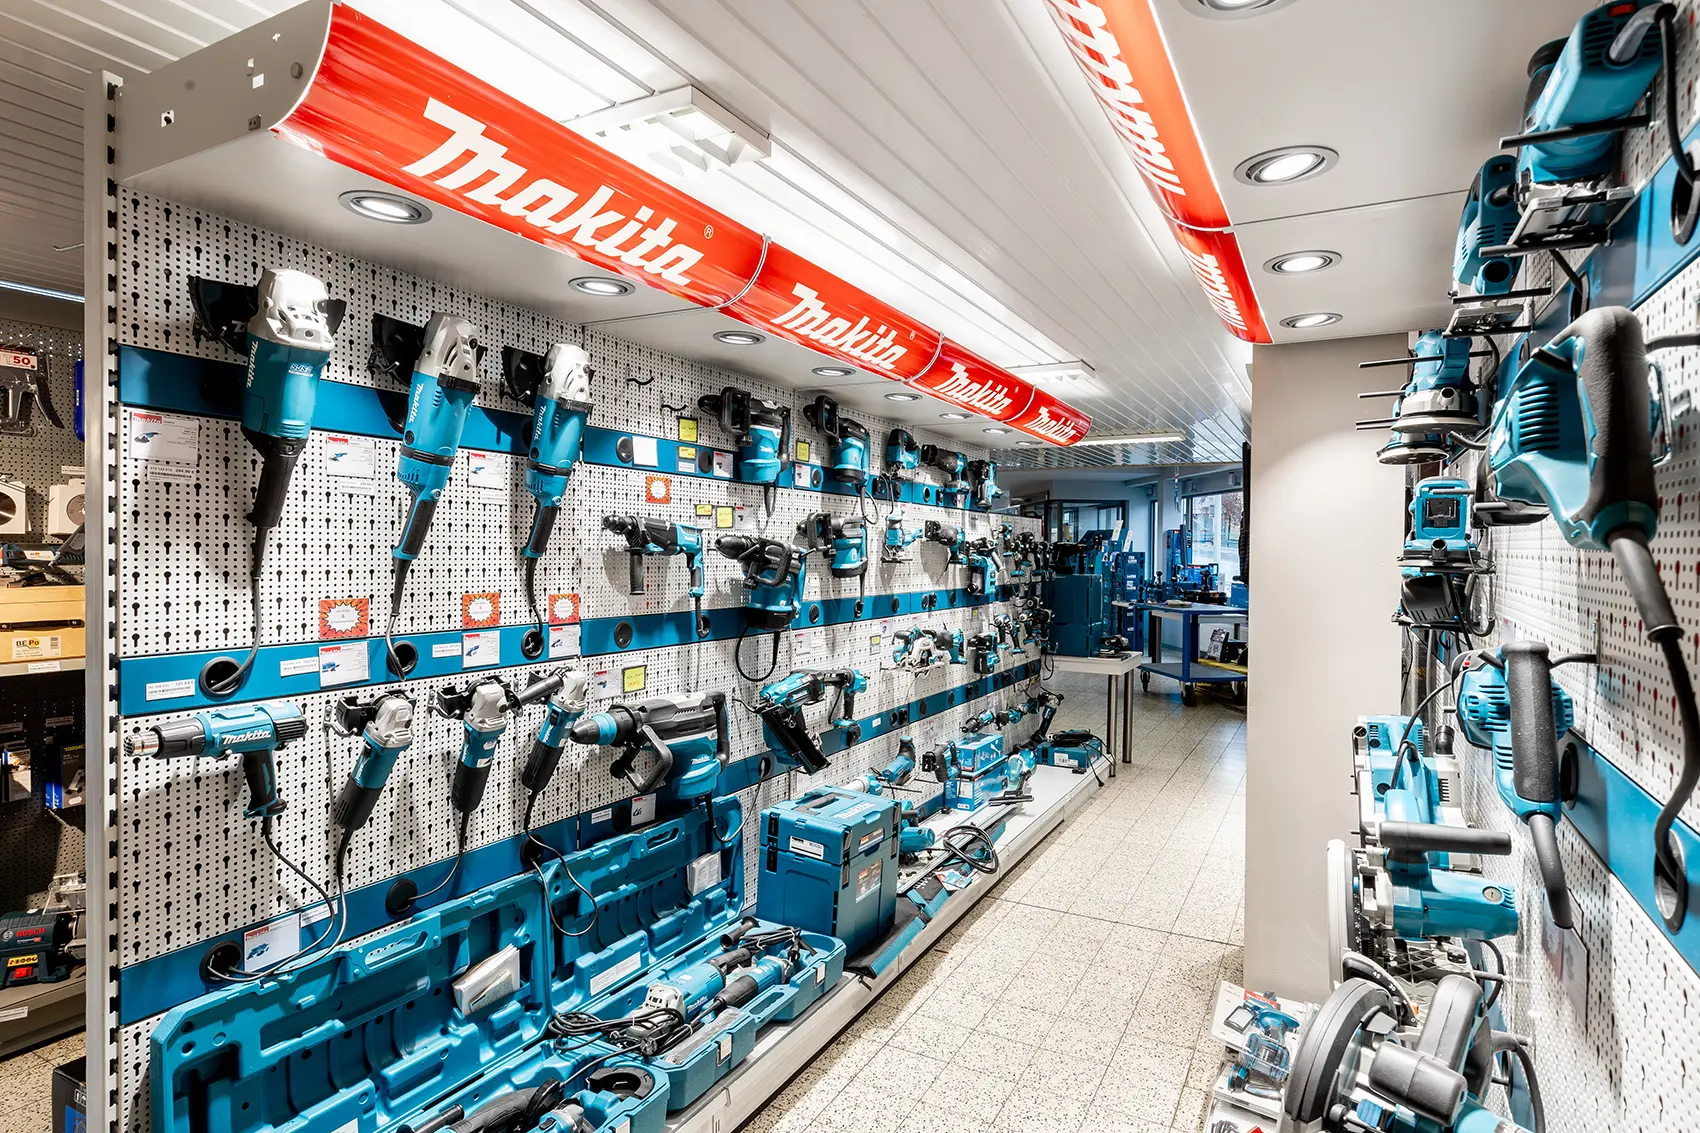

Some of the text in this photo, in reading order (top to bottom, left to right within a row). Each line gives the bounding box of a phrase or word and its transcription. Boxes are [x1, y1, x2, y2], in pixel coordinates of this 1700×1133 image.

[400, 96, 704, 287] makita
[770, 282, 908, 371] makita
[408, 382, 425, 424] makita
[932, 361, 1013, 416] makita
[1023, 405, 1078, 444] makita
[221, 729, 272, 745] makita
[16, 927, 47, 937] BOSCH
